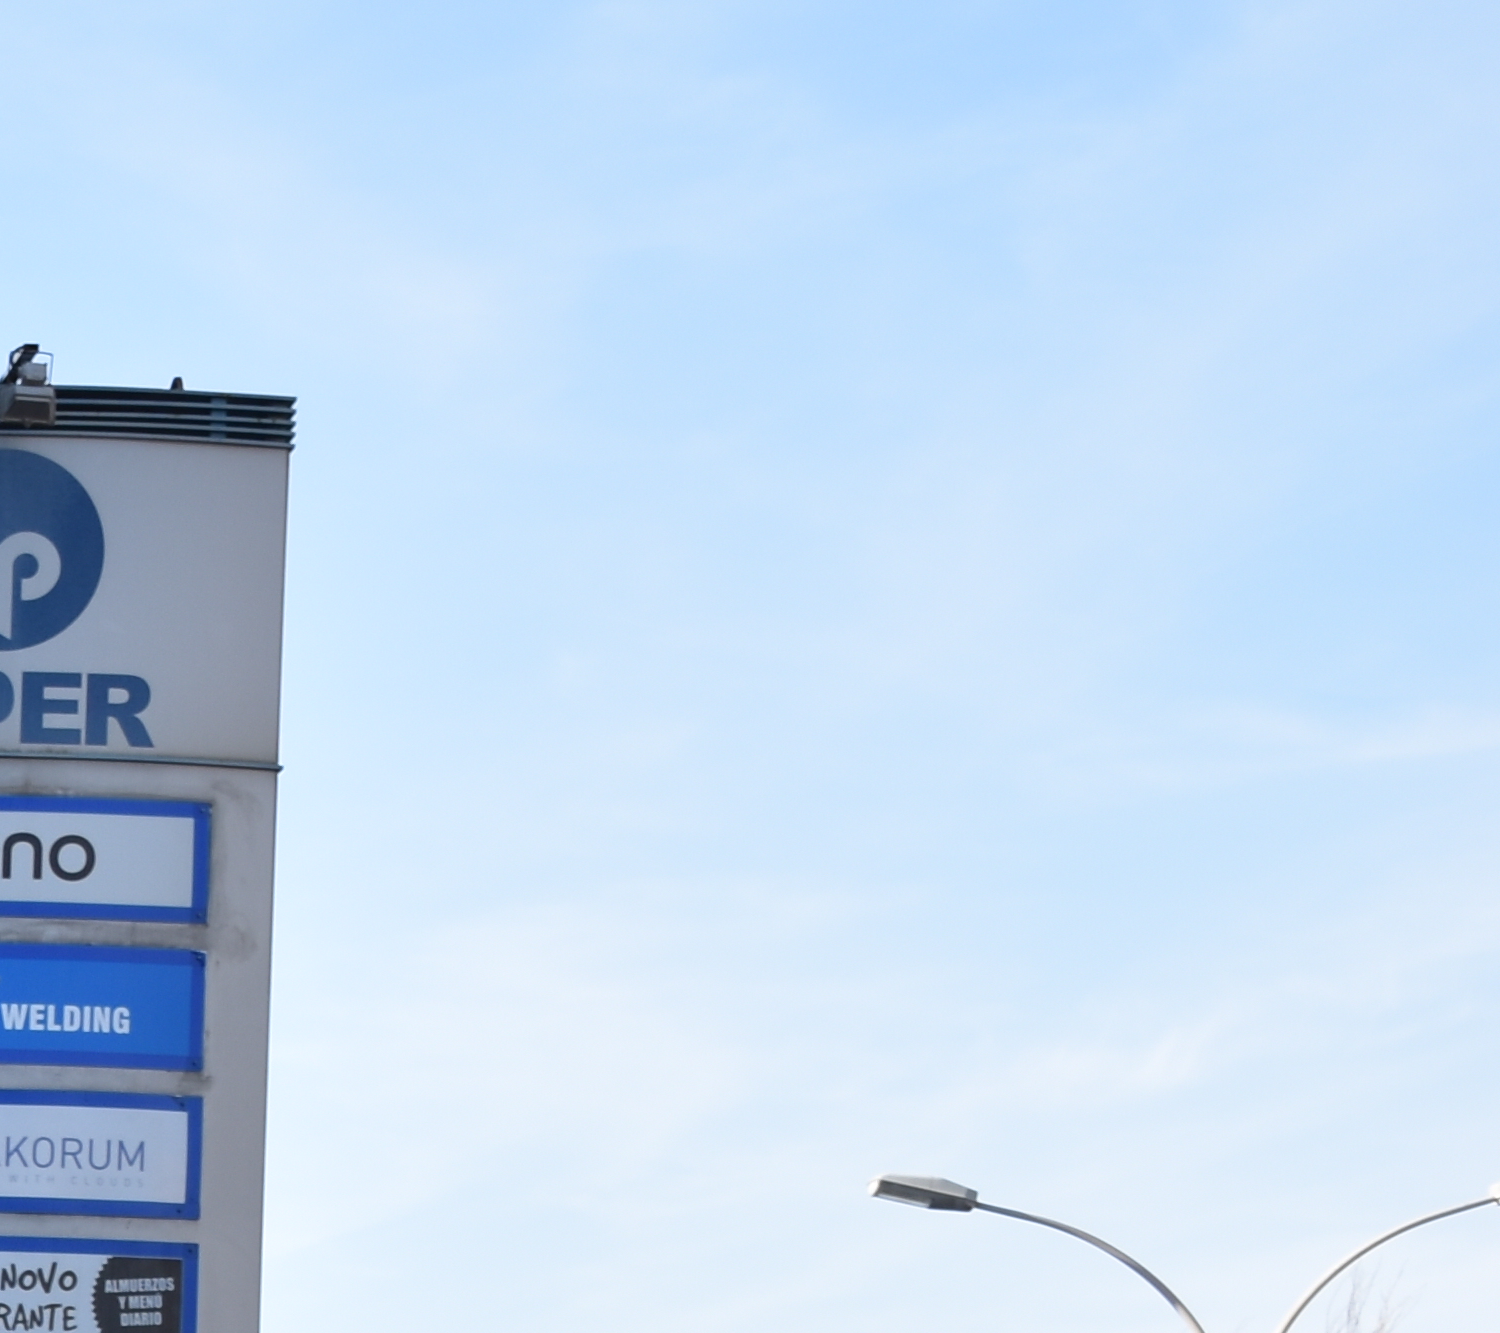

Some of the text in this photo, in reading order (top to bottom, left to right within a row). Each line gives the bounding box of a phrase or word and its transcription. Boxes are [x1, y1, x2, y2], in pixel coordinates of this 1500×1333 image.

[0, 1003, 131, 1036] WELDING
[9, 1173, 55, 1184] WITH
[71, 1176, 146, 1189] CLOUDS
[104, 1277, 175, 1293] ALMUERZOS
[118, 1295, 127, 1310] Y
[120, 1311, 162, 1327] DIARIO
